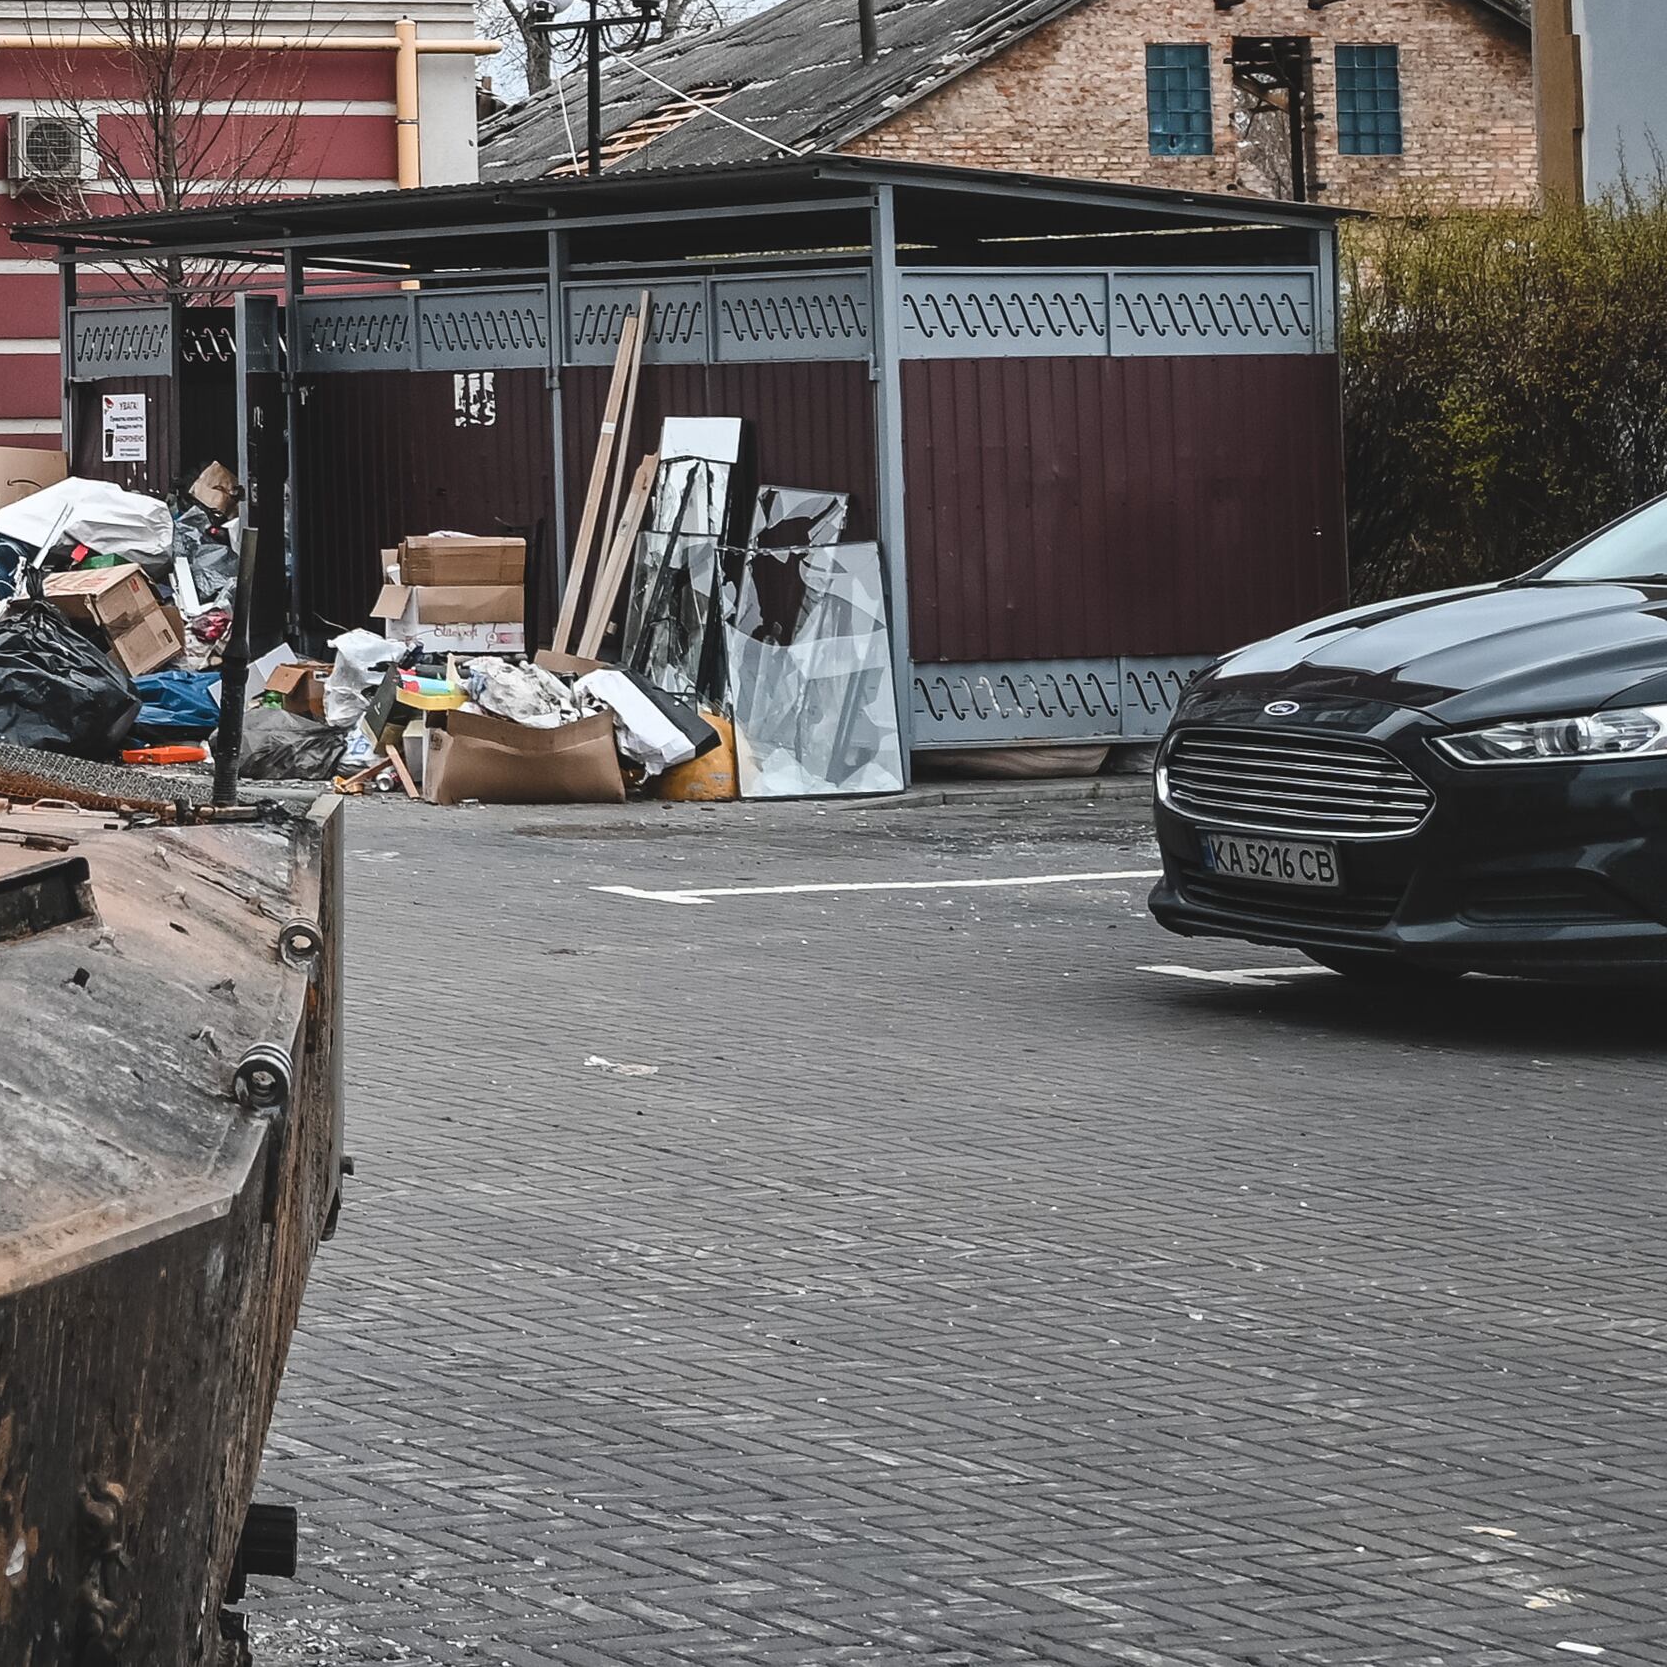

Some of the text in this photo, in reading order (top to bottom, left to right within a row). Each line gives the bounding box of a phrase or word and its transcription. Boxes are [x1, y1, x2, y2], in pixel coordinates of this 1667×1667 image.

[1210, 839, 1335, 883] KA 5216 CB
